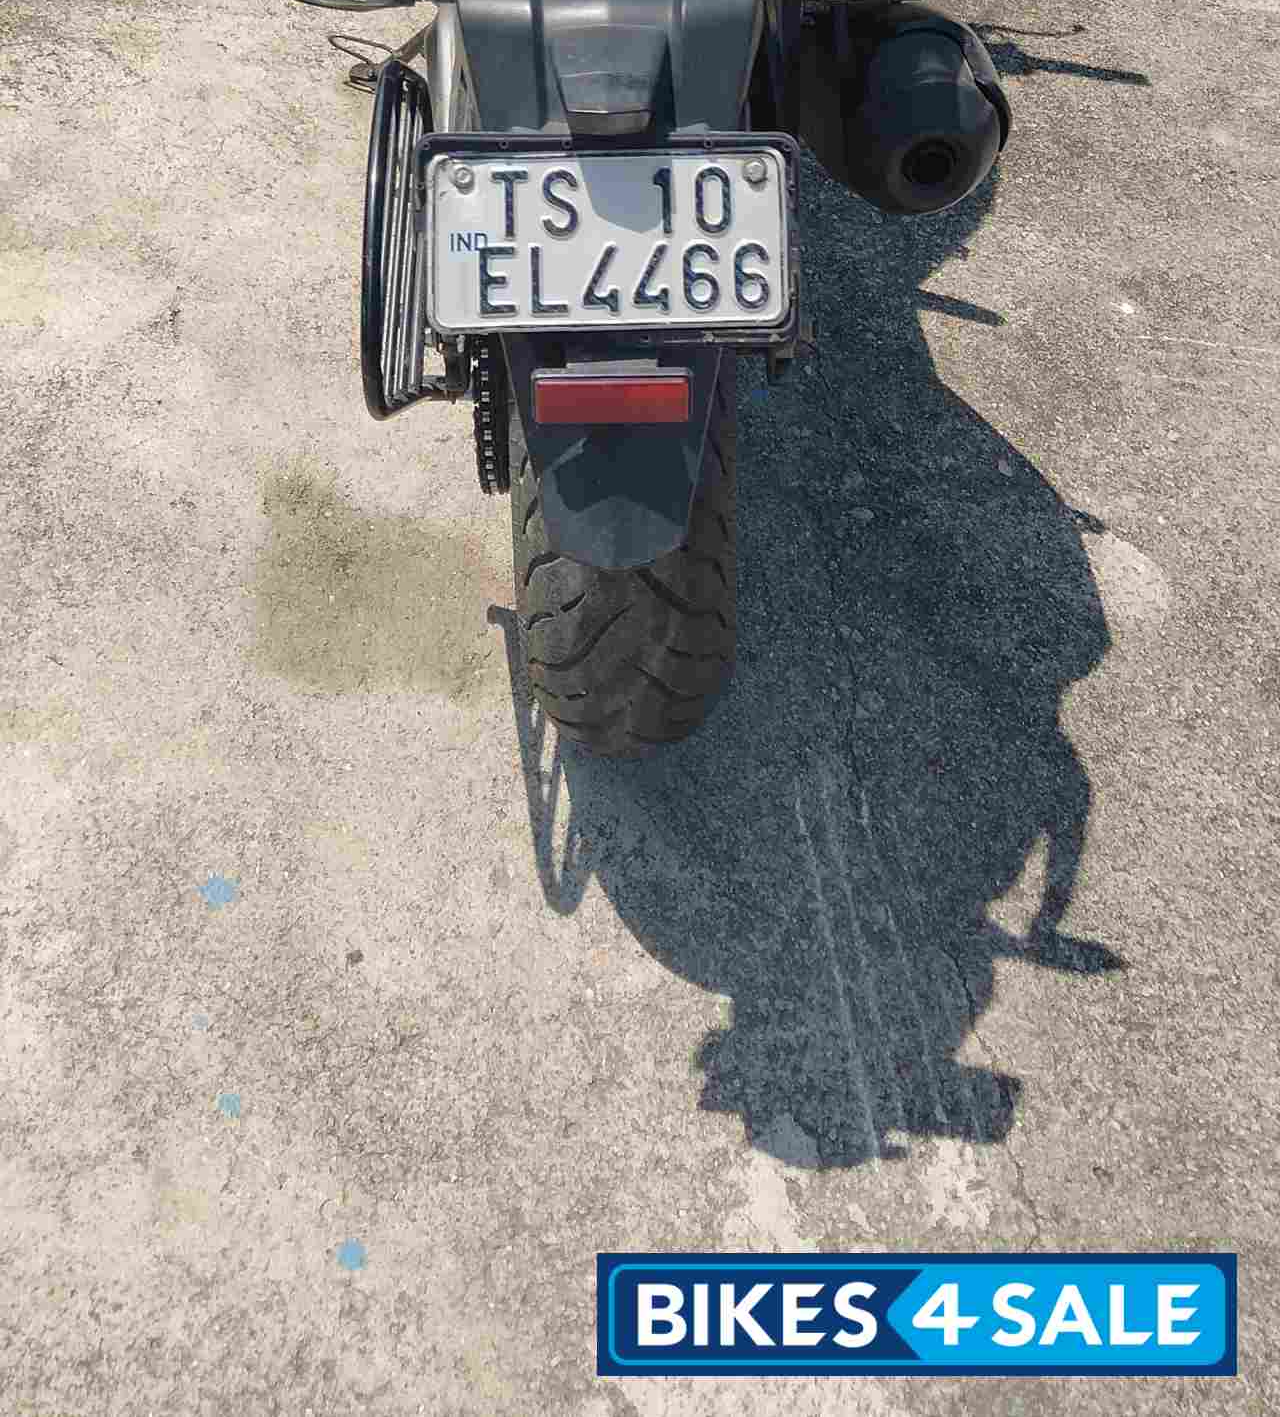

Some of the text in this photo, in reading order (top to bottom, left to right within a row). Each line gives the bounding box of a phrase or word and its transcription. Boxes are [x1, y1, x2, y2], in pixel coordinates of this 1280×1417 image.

[490, 165, 732, 238] TS 10
[449, 232, 489, 252] IND
[479, 242, 771, 317] EL4466
